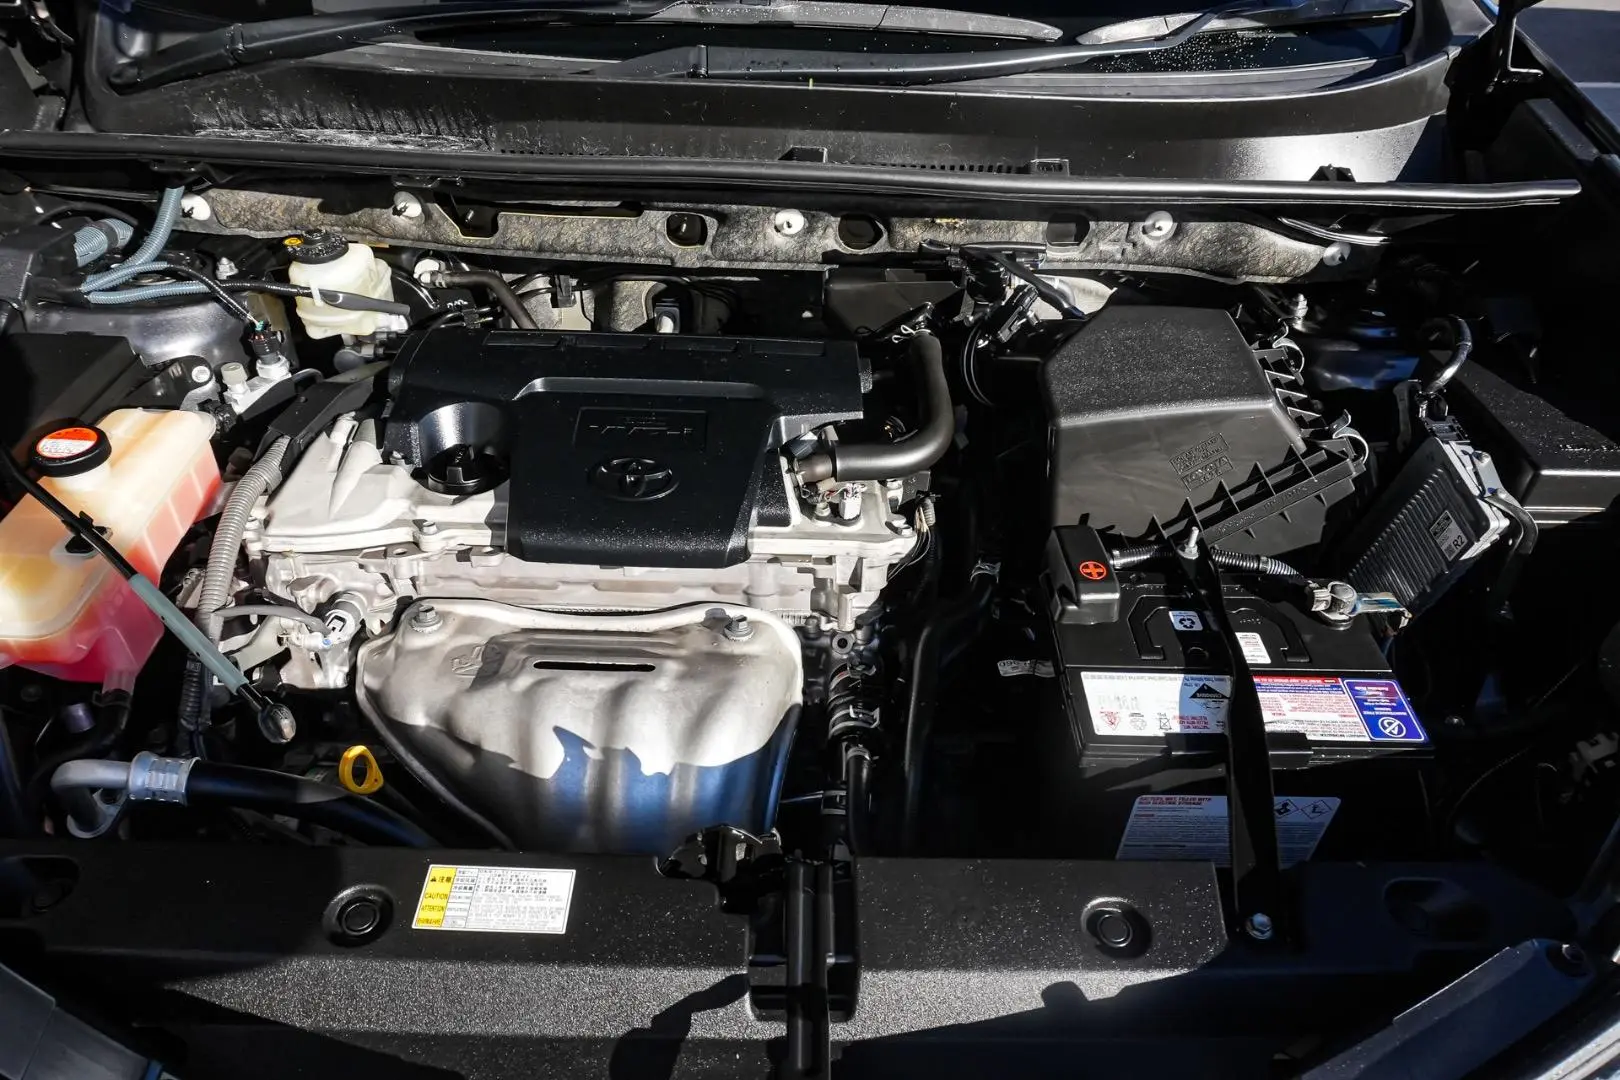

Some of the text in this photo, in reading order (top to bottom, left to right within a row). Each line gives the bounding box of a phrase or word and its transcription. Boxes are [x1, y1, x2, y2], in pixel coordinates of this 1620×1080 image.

[1453, 535, 1465, 549] R2
[424, 892, 449, 900] CAUTION
[421, 904, 445, 912] ATTENTION
